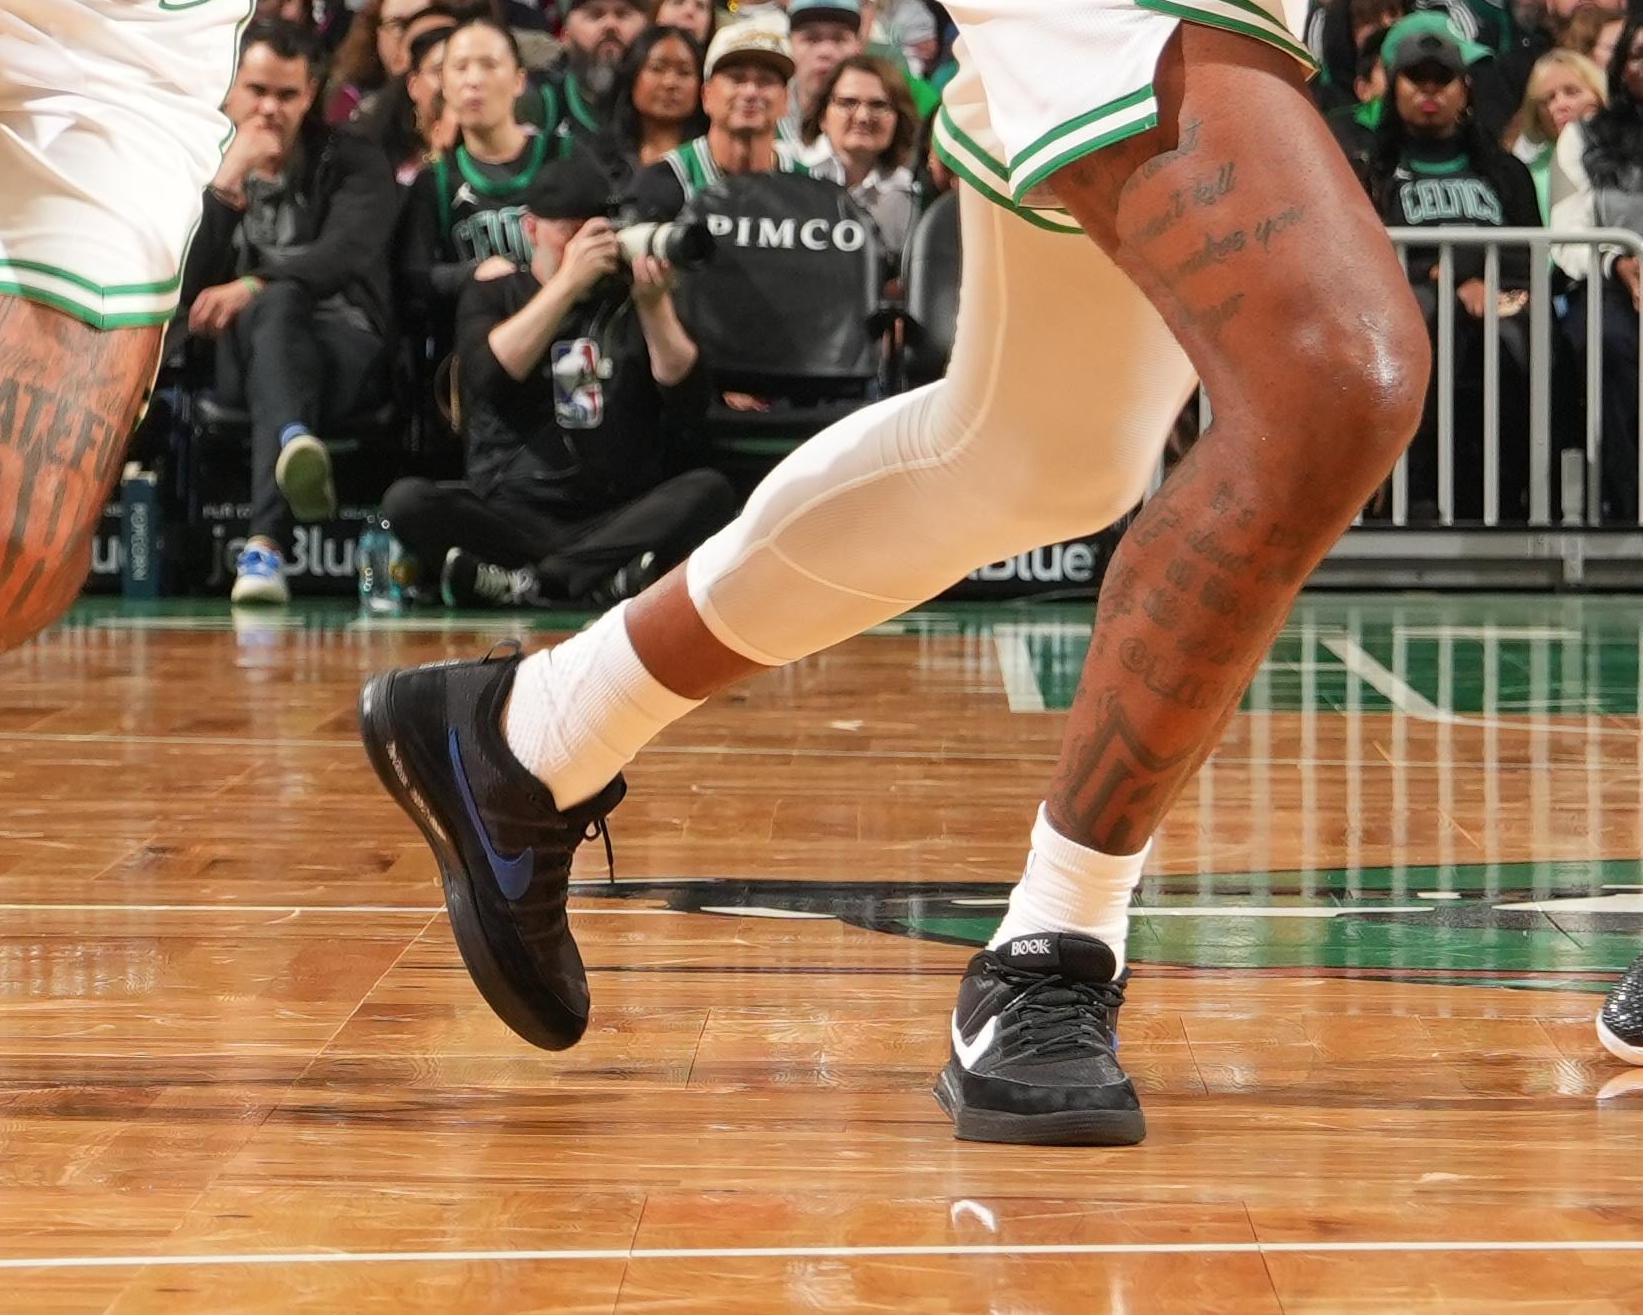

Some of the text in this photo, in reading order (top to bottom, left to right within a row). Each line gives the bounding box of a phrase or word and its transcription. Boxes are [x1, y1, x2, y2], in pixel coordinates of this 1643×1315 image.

[1399, 178, 1504, 226] CELTICS
[706, 213, 865, 252] PIMCO
[1010, 938, 1052, 957] BOOK
